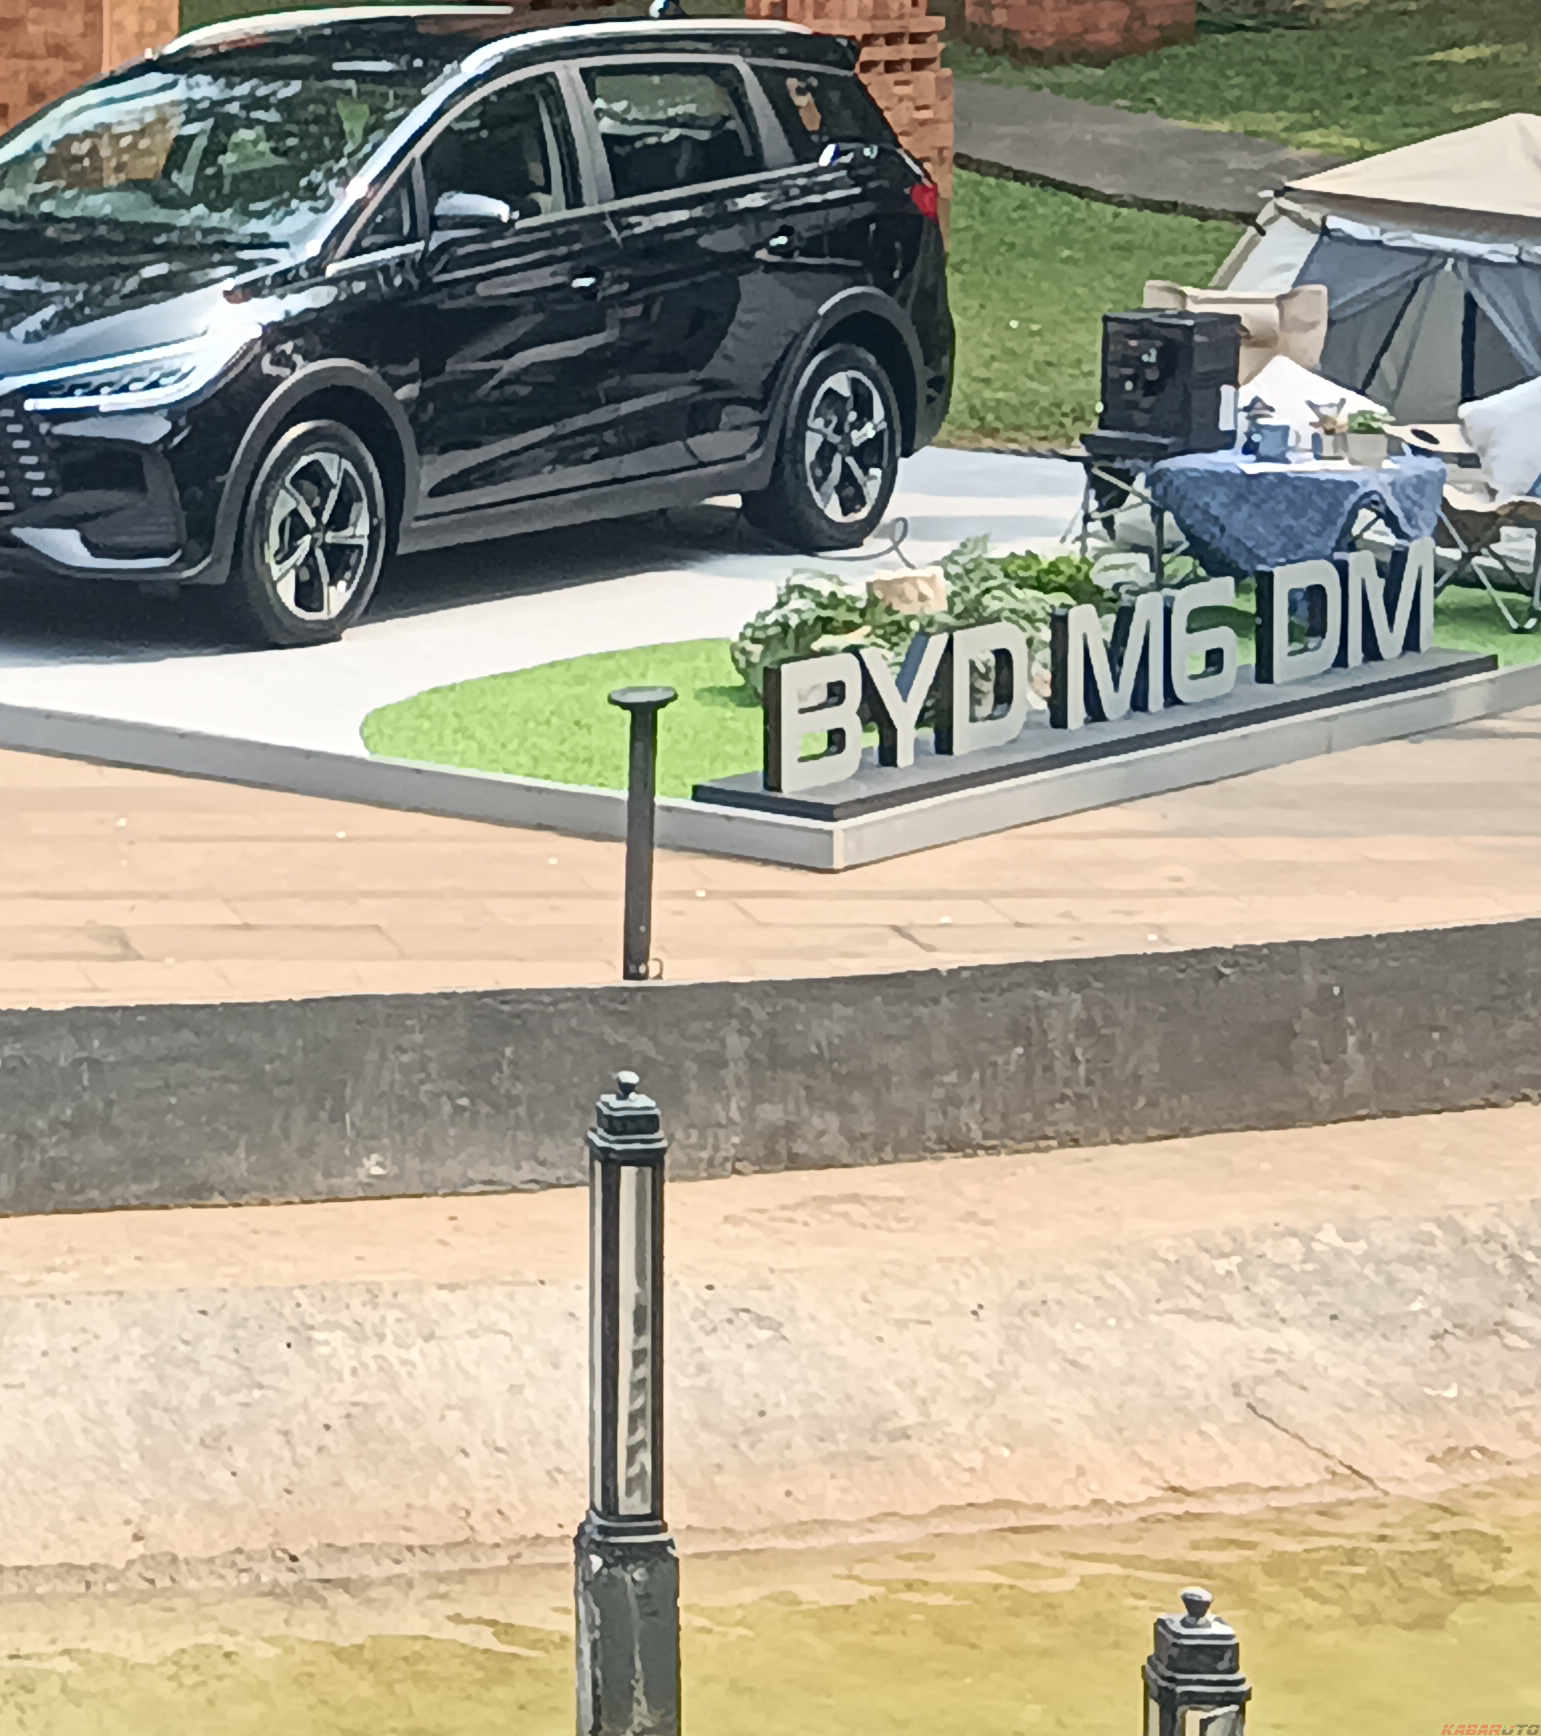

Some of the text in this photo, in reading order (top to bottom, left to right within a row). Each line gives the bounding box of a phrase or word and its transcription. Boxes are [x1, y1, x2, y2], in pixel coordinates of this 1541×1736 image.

[764, 538, 1435, 792] BYD M6 DM
